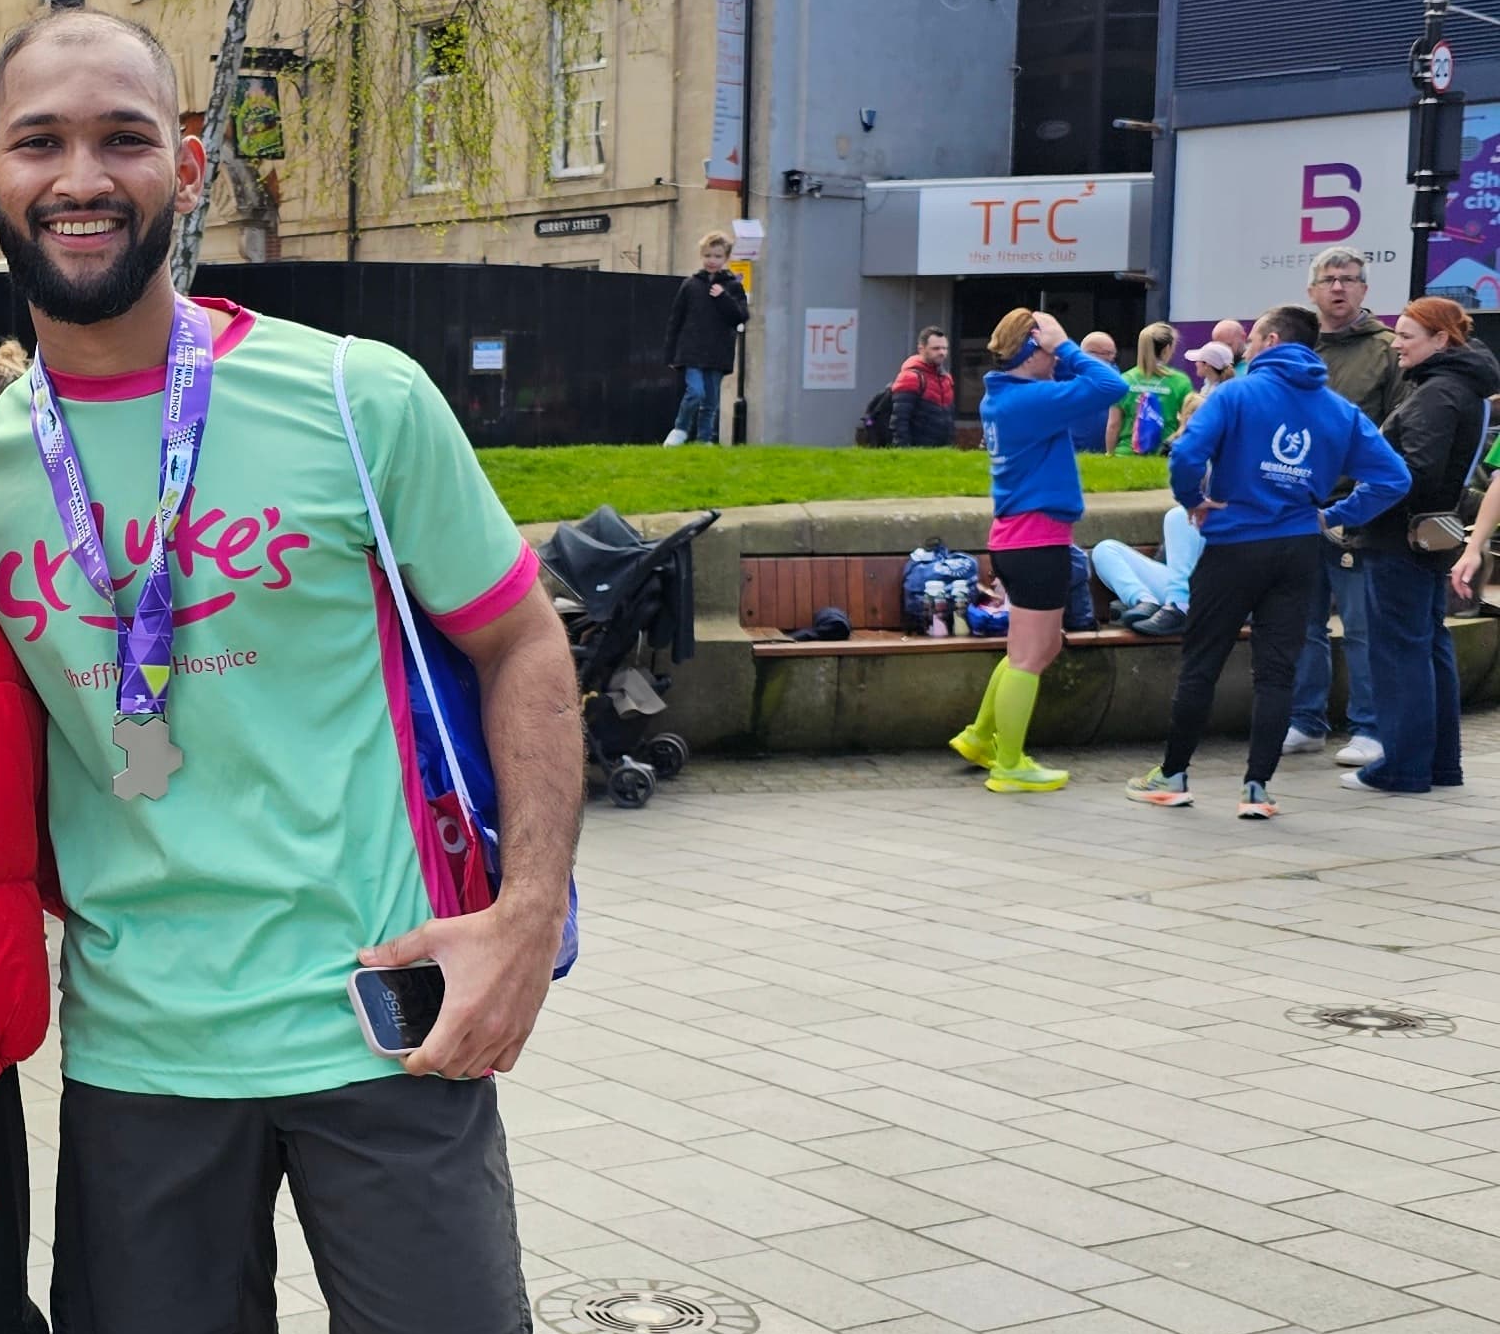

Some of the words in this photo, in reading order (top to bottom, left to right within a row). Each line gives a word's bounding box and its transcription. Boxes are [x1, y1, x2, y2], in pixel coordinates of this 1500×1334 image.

[1469, 170, 1500, 189] Sh
[539, 221, 569, 234] SURREY
[571, 218, 602, 231] STREET
[970, 198, 1079, 246] TFC
[969, 250, 991, 264] the
[997, 250, 1044, 264] fitness
[1049, 247, 1077, 263] club
[807, 323, 848, 355] TFC
[170, 366, 183, 420] MARATHON
[63, 661, 118, 690] heffi
[172, 648, 258, 676] Hospice
[382, 989, 408, 1031] 11:55
